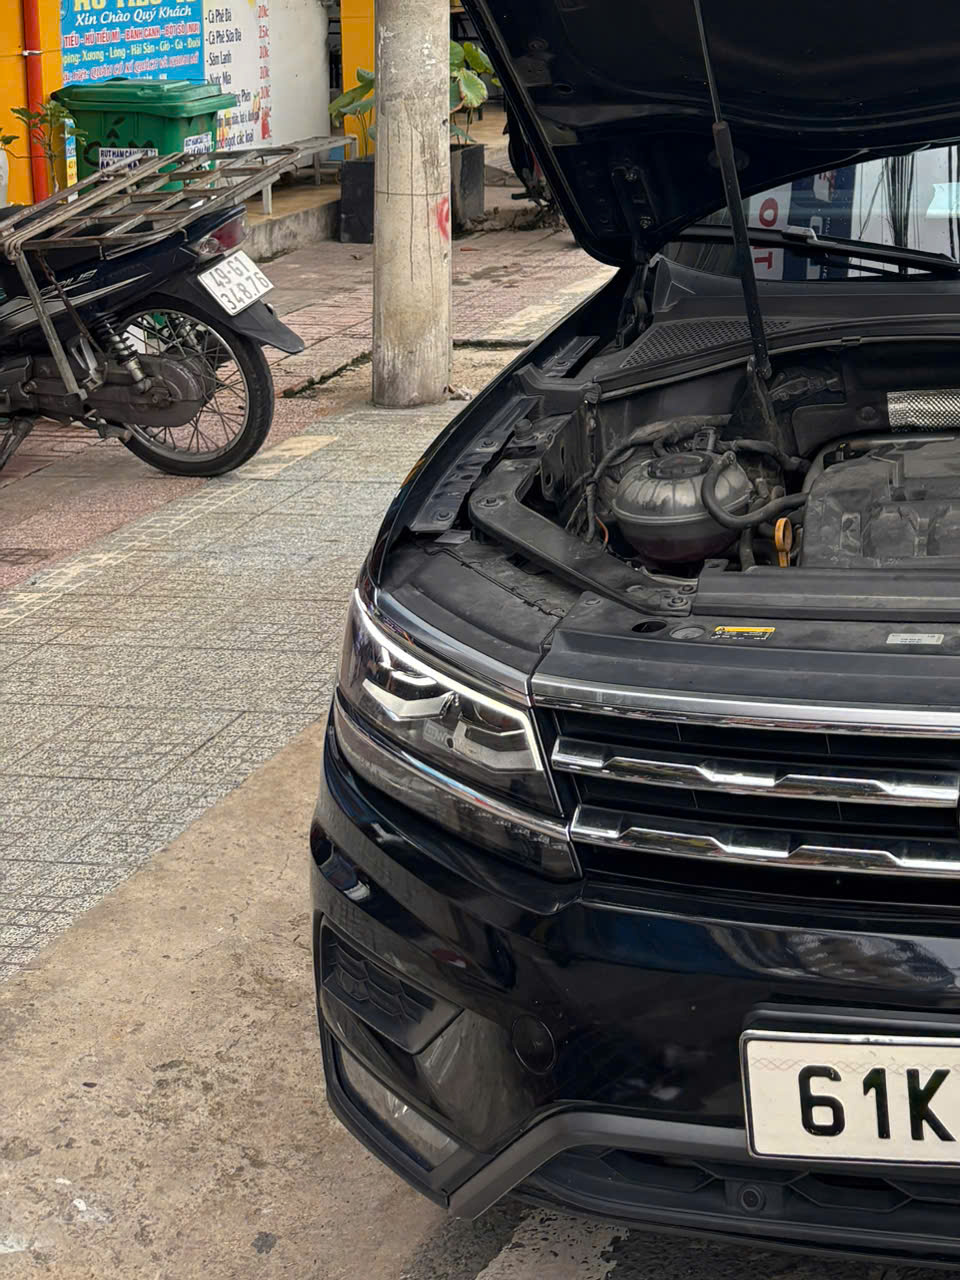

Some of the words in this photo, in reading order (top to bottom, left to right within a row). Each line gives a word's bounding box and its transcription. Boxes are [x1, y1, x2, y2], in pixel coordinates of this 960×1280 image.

[75, 13, 97, 26] Xin
[100, 10, 130, 23] Chào
[134, 7, 156, 22] Quý
[159, 5, 192, 18] Khách
